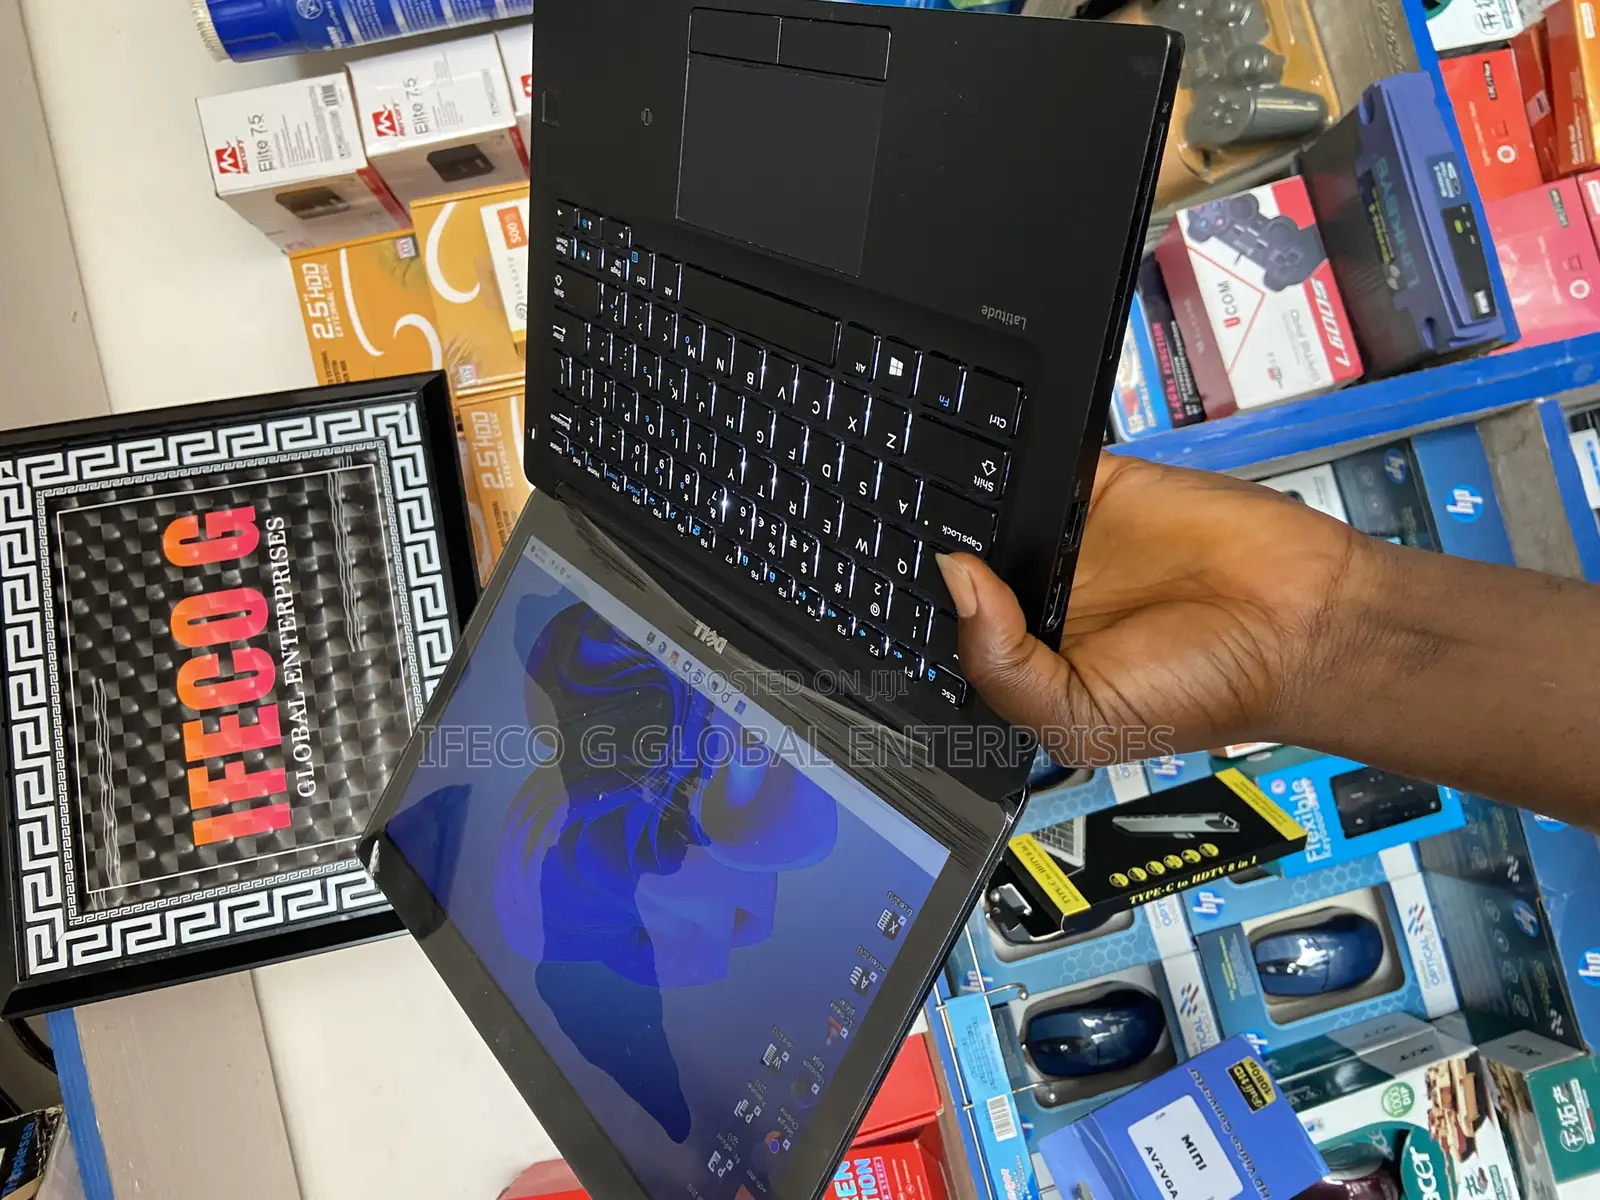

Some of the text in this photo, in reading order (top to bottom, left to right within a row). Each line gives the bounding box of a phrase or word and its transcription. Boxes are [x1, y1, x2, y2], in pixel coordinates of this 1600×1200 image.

[404, 78, 430, 135] Elite 7.5
[247, 114, 273, 173] Elite 7.5
[981, 305, 1027, 330] Latitude
[688, 345, 695, 358] M
[717, 358, 724, 371] N
[855, 362, 866, 373] Alt
[647, 375, 652, 387] L
[747, 371, 754, 385] B
[671, 388, 678, 400] K
[778, 386, 785, 400] V
[699, 401, 705, 412] J
[812, 401, 820, 414] C
[939, 395, 950, 407] Fn
[550, 413, 570, 430] Backspace
[624, 412, 630, 422] P
[726, 415, 734, 428] H
[989, 414, 1007, 428] Ctrl
[648, 424, 655, 435] O
[848, 416, 857, 432] X
[756, 431, 764, 443] G
[886, 433, 896, 449] Z
[700, 452, 706, 465] U
[788, 448, 796, 460] F
[587, 467, 600, 478] Home
[728, 468, 734, 481] Y
[822, 464, 831, 478] D
[859, 482, 867, 495] S
[974, 475, 994, 492] Shift
[758, 485, 765, 498] T
[741, 507, 746, 517] 6
[789, 501, 797, 515] R
[899, 499, 908, 514] A
[653, 509, 662, 518] F10
[678, 524, 684, 533] F9
[771, 524, 776, 535] 5
[823, 519, 831, 534] E
[701, 539, 708, 548] F8
[942, 525, 982, 551] Caps Lock
[769, 543, 775, 555] %
[803, 543, 809, 553] 4
[856, 538, 868, 555] W
[725, 555, 732, 564] F7
[897, 558, 907, 574] Q
[801, 562, 807, 574] $
[837, 563, 844, 575] 3
[751, 571, 759, 580] F6
[779, 588, 787, 598] F5
[834, 583, 842, 593] #
[874, 582, 881, 595] 2
[807, 606, 816, 616] F4
[870, 602, 880, 617] @
[837, 624, 846, 635] F3
[692, 619, 728, 654] DELL
[870, 644, 879, 656] F2
[265, 515, 318, 799] GLOBAL ENTERPRISES
[162, 506, 291, 846] IFECO G
[904, 666, 913, 678] F1
[941, 688, 956, 704] Esc
[1289, 777, 1322, 863] Flexible
[1129, 884, 1175, 905] TYPE-C
[1176, 879, 1189, 890] to
[1192, 865, 1226, 884] HDTV
[1227, 862, 1236, 873] 8
[1237, 859, 1249, 870] in
[1193, 891, 1226, 915] hp
[1188, 1067, 1233, 1136] Converter
[1388, 1087, 1403, 1115] 1000
[1399, 1086, 1412, 1105] DIP
[1231, 1135, 1257, 1178] Video
[1145, 1146, 1179, 1199] AV2VGA
[1409, 1147, 1441, 1200] acer
